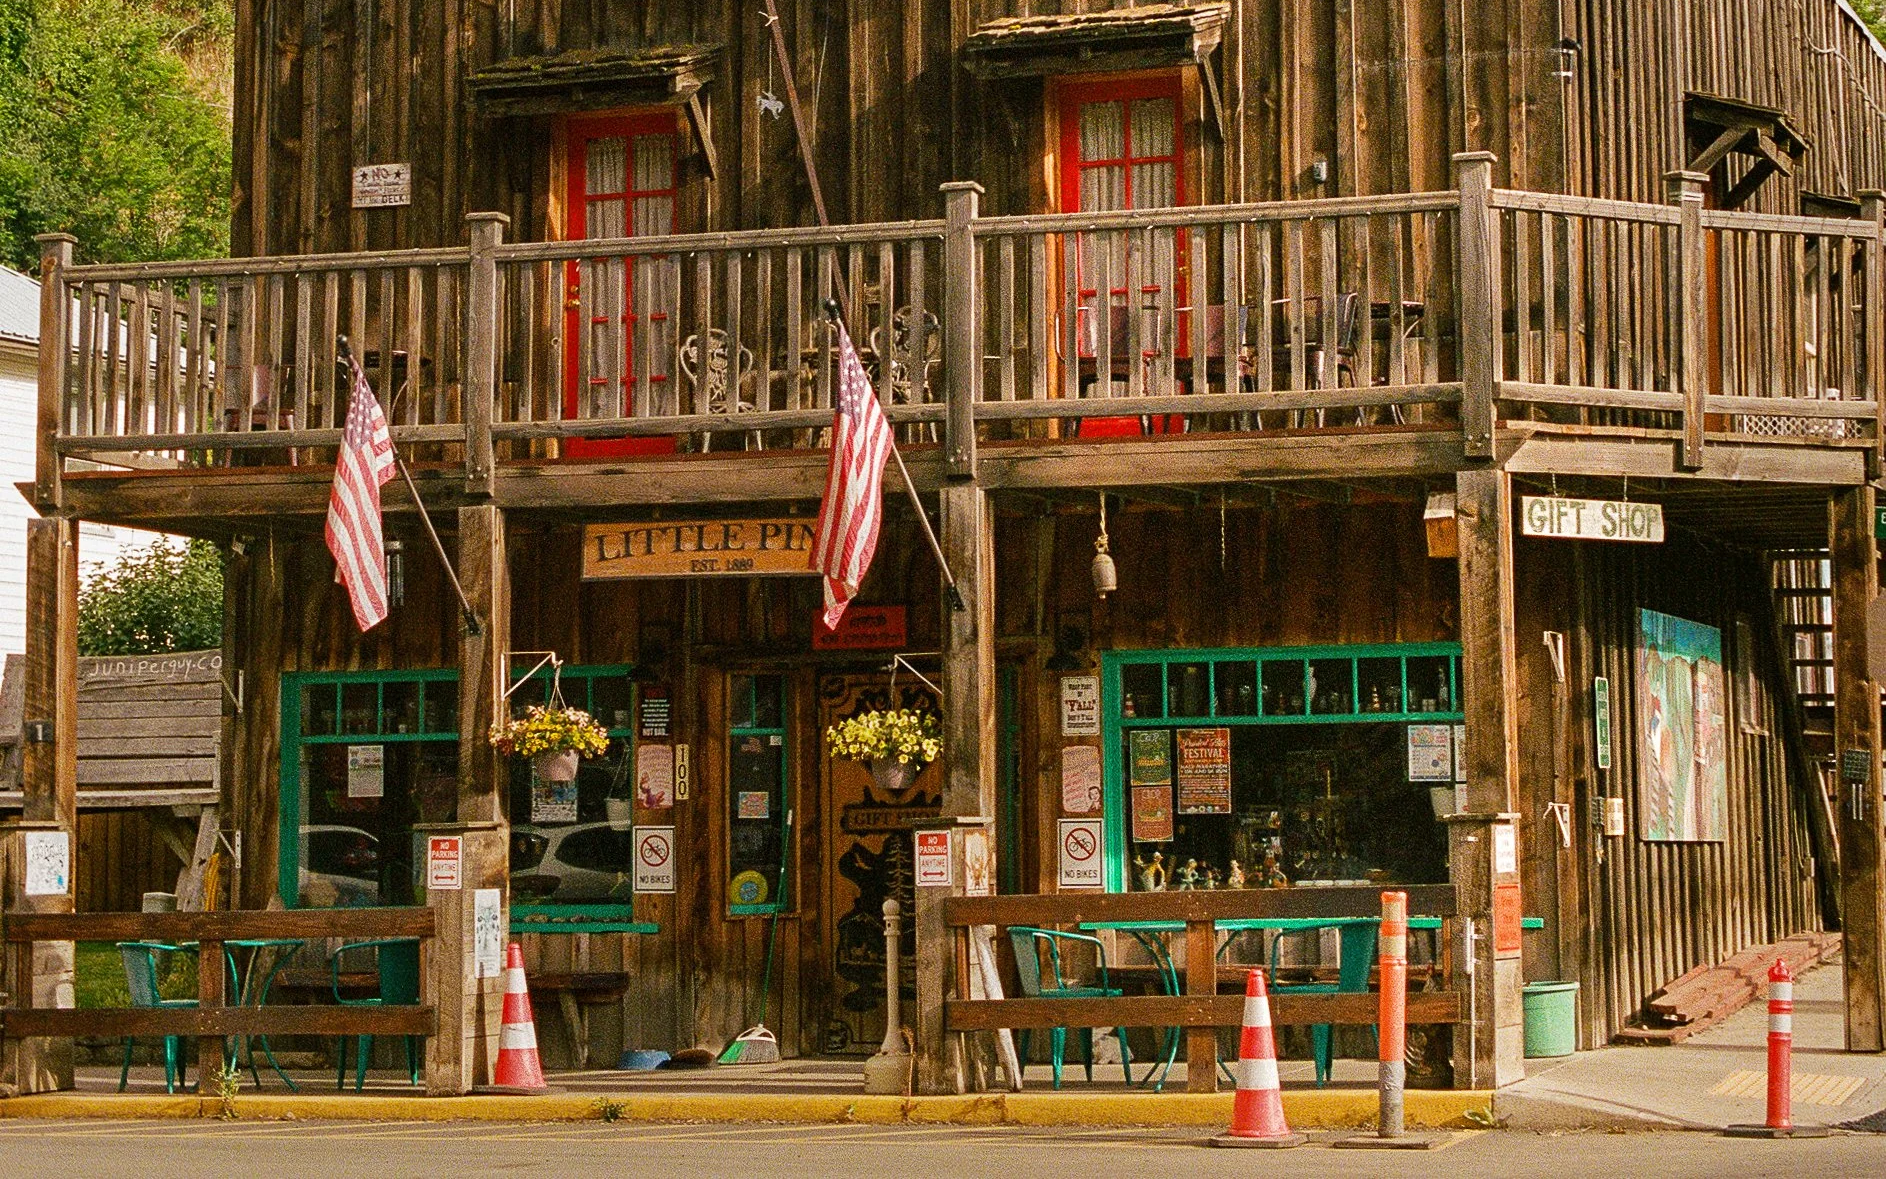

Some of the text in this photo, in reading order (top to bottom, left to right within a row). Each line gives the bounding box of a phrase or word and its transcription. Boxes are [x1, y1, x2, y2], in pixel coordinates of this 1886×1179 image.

[371, 167, 389, 181] NO
[1527, 498, 1660, 539] GIFT SHOP
[595, 522, 817, 562] LITTLE PIN
[35, 724, 44, 741] 1
[1184, 748, 1225, 759] FESTIVAL
[677, 746, 687, 796] 100
[440, 841, 450, 850] NO
[927, 836, 938, 845] NO
[431, 850, 459, 859] PARKING
[919, 845, 947, 854] PARKING
[1064, 869, 1098, 879] NO BIKES
[639, 875, 671, 884] NO BIKES
